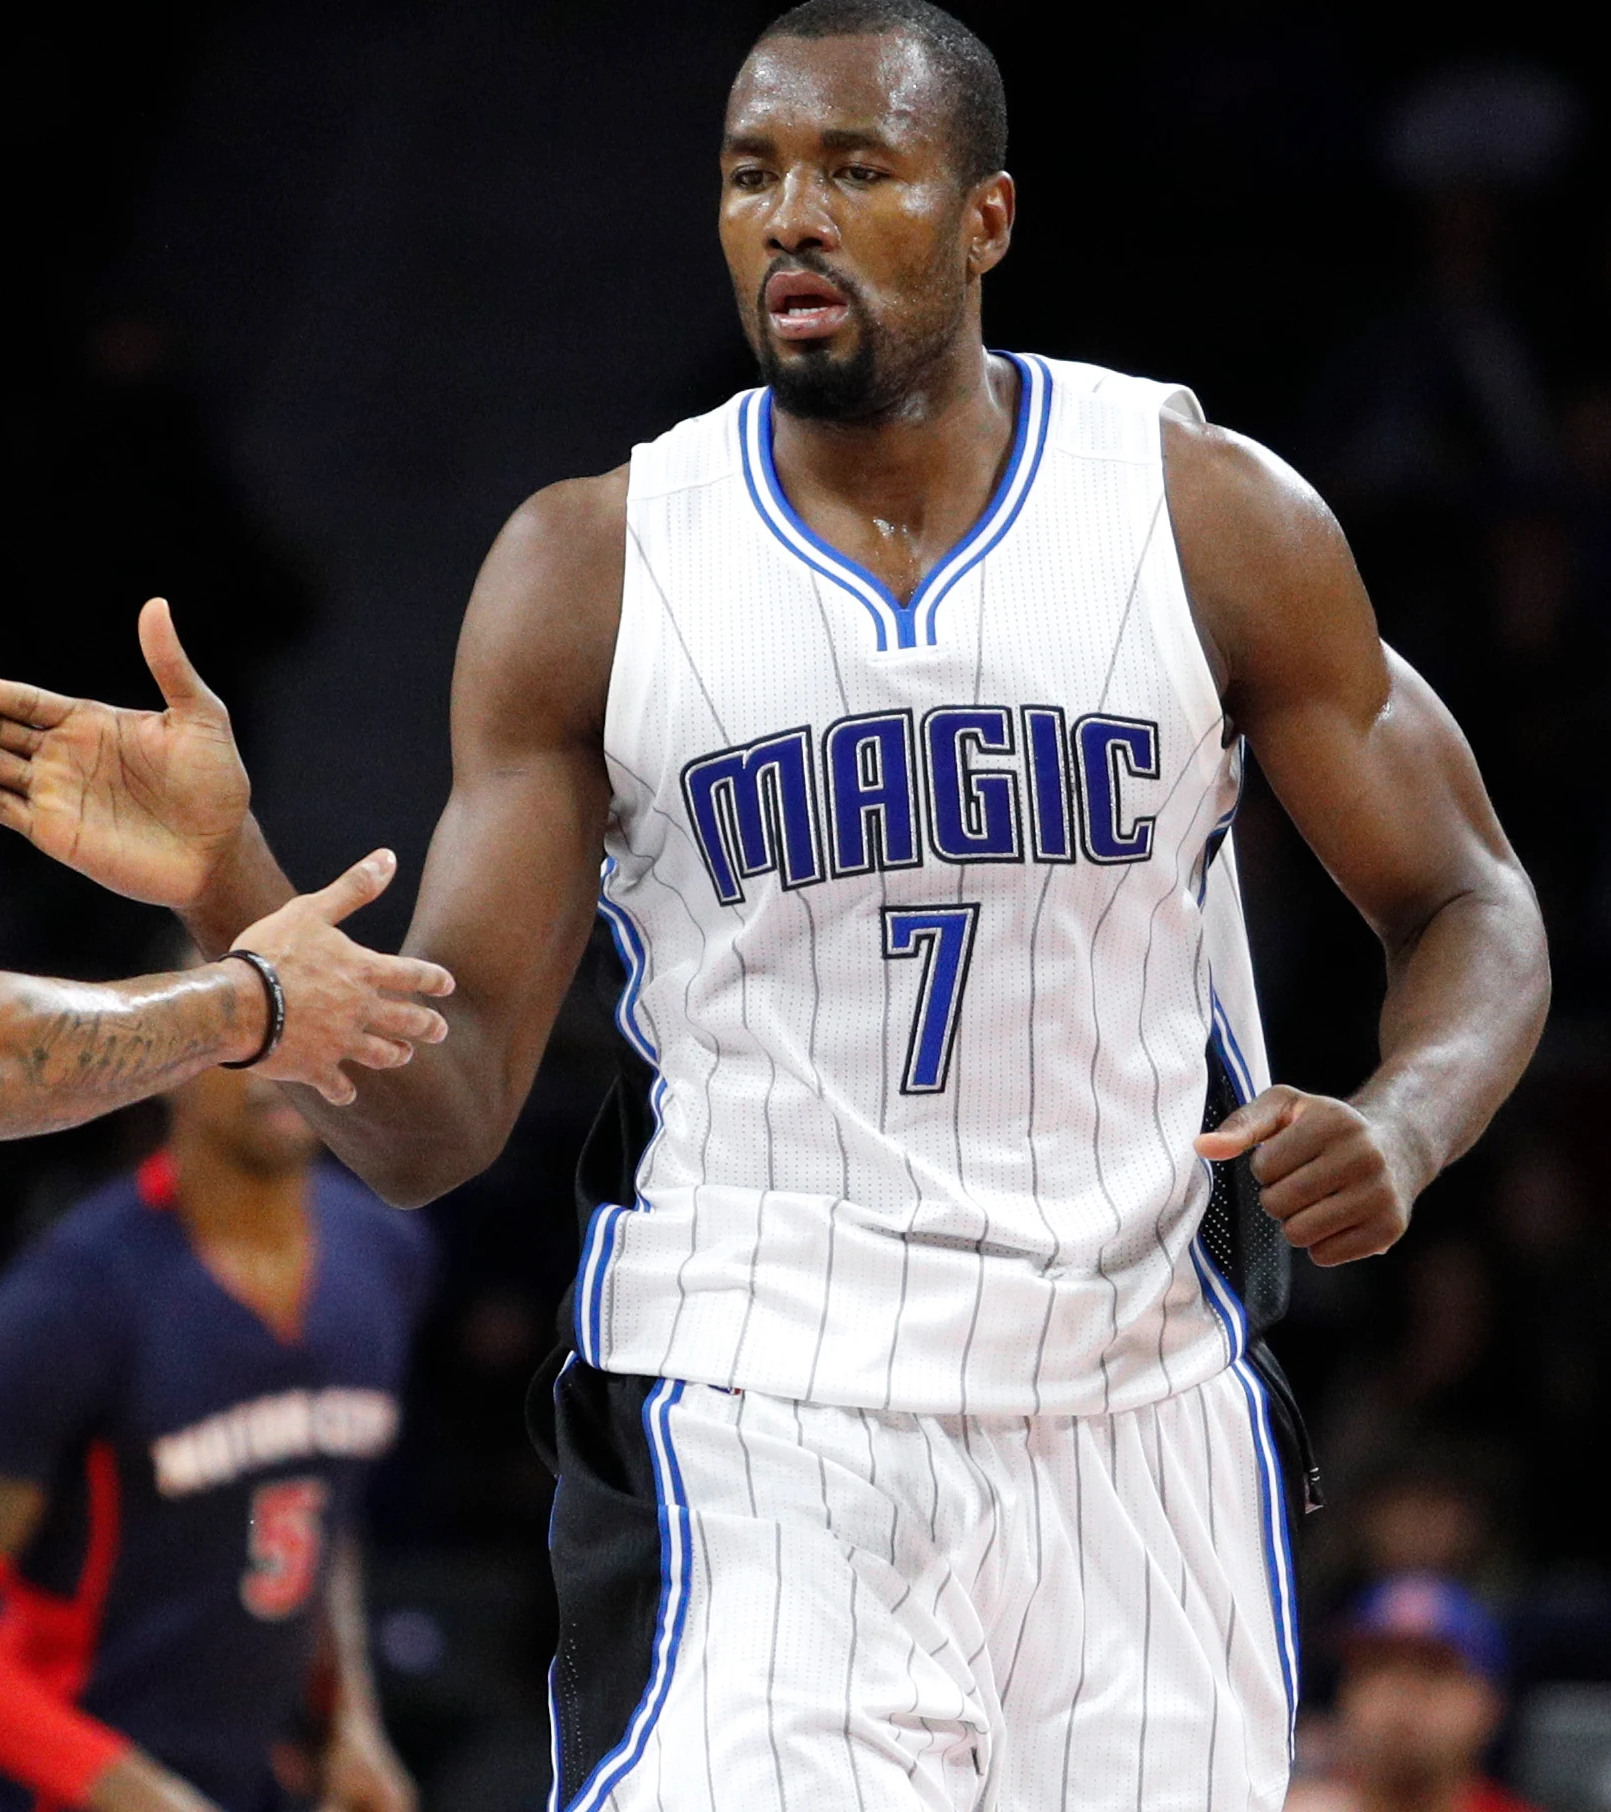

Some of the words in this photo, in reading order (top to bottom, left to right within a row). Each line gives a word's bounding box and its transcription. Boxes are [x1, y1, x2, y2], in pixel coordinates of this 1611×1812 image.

[680, 704, 1160, 906] MAGIC
[879, 902, 980, 1094] 7
[239, 1476, 327, 1621] 5
